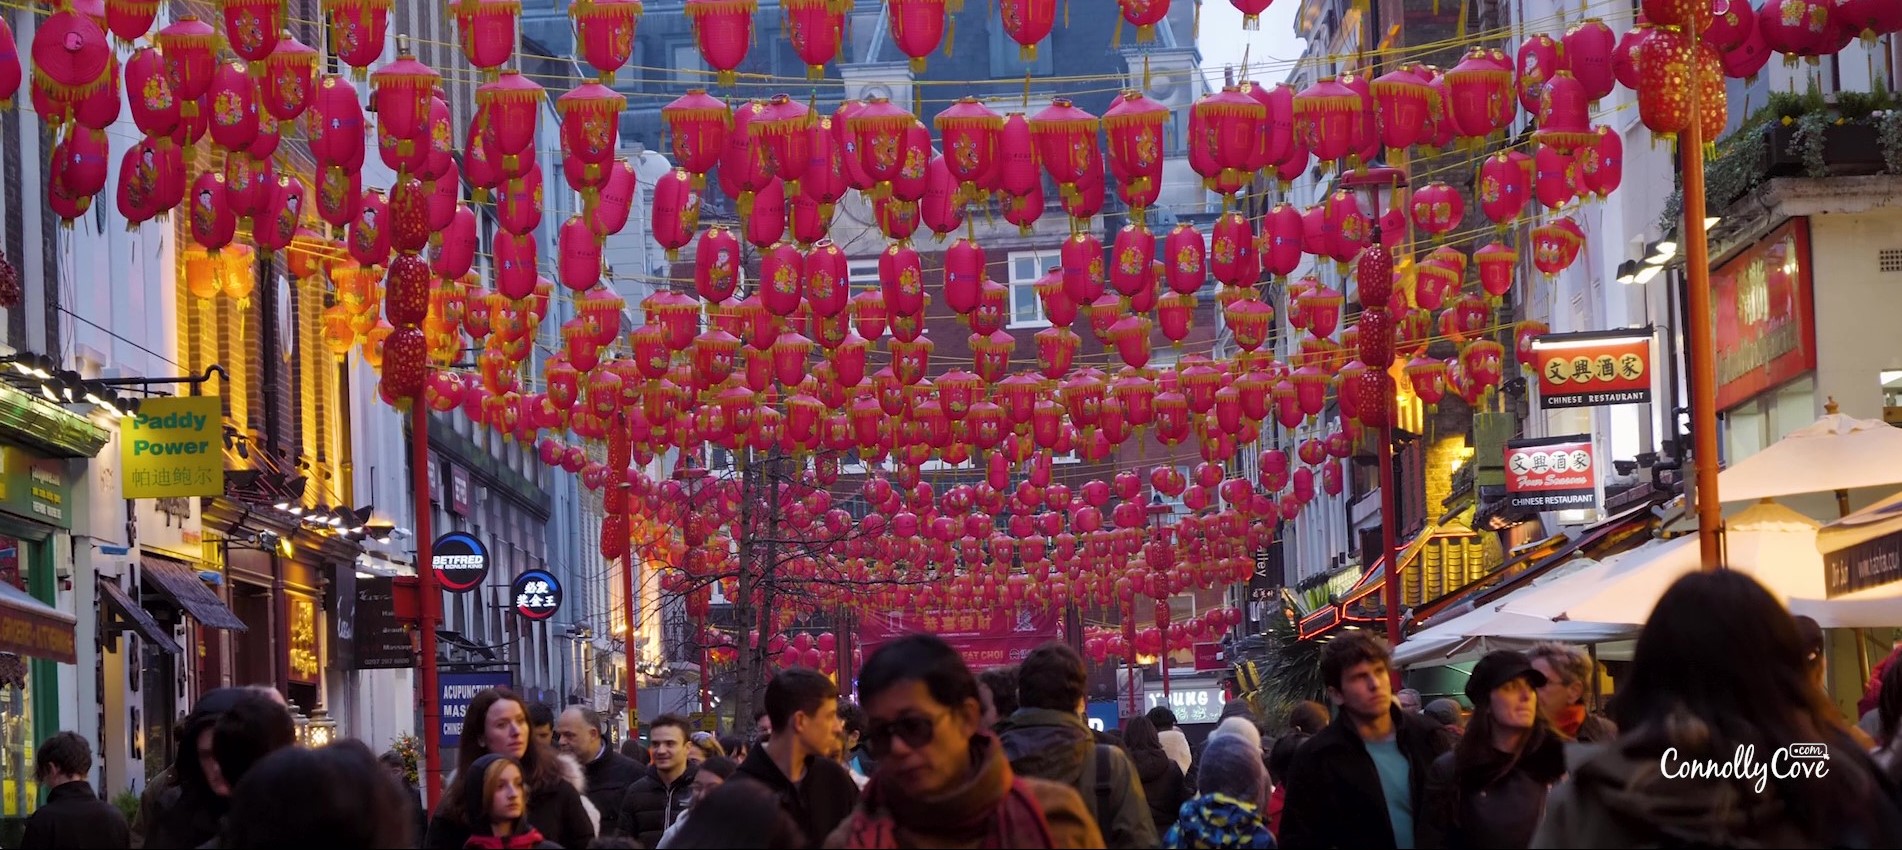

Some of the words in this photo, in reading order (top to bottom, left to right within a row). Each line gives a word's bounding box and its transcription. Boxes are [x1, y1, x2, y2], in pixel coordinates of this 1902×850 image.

[1549, 356, 1639, 381] 文興酒家
[1547, 395, 1583, 405] CHINESE
[1588, 391, 1645, 403] RESTAURANT
[133, 411, 207, 432] Paddy
[134, 440, 209, 456] Power
[1513, 452, 1588, 471] 文興酒家
[1516, 475, 1544, 490] Four
[1544, 473, 1588, 487] Seasons
[1511, 496, 1544, 507] CHINESE
[1544, 493, 1594, 505] RESTAURANT
[432, 554, 484, 565] BETFRED
[1255, 544, 1269, 577] alley
[517, 594, 557, 607] 奖金王
